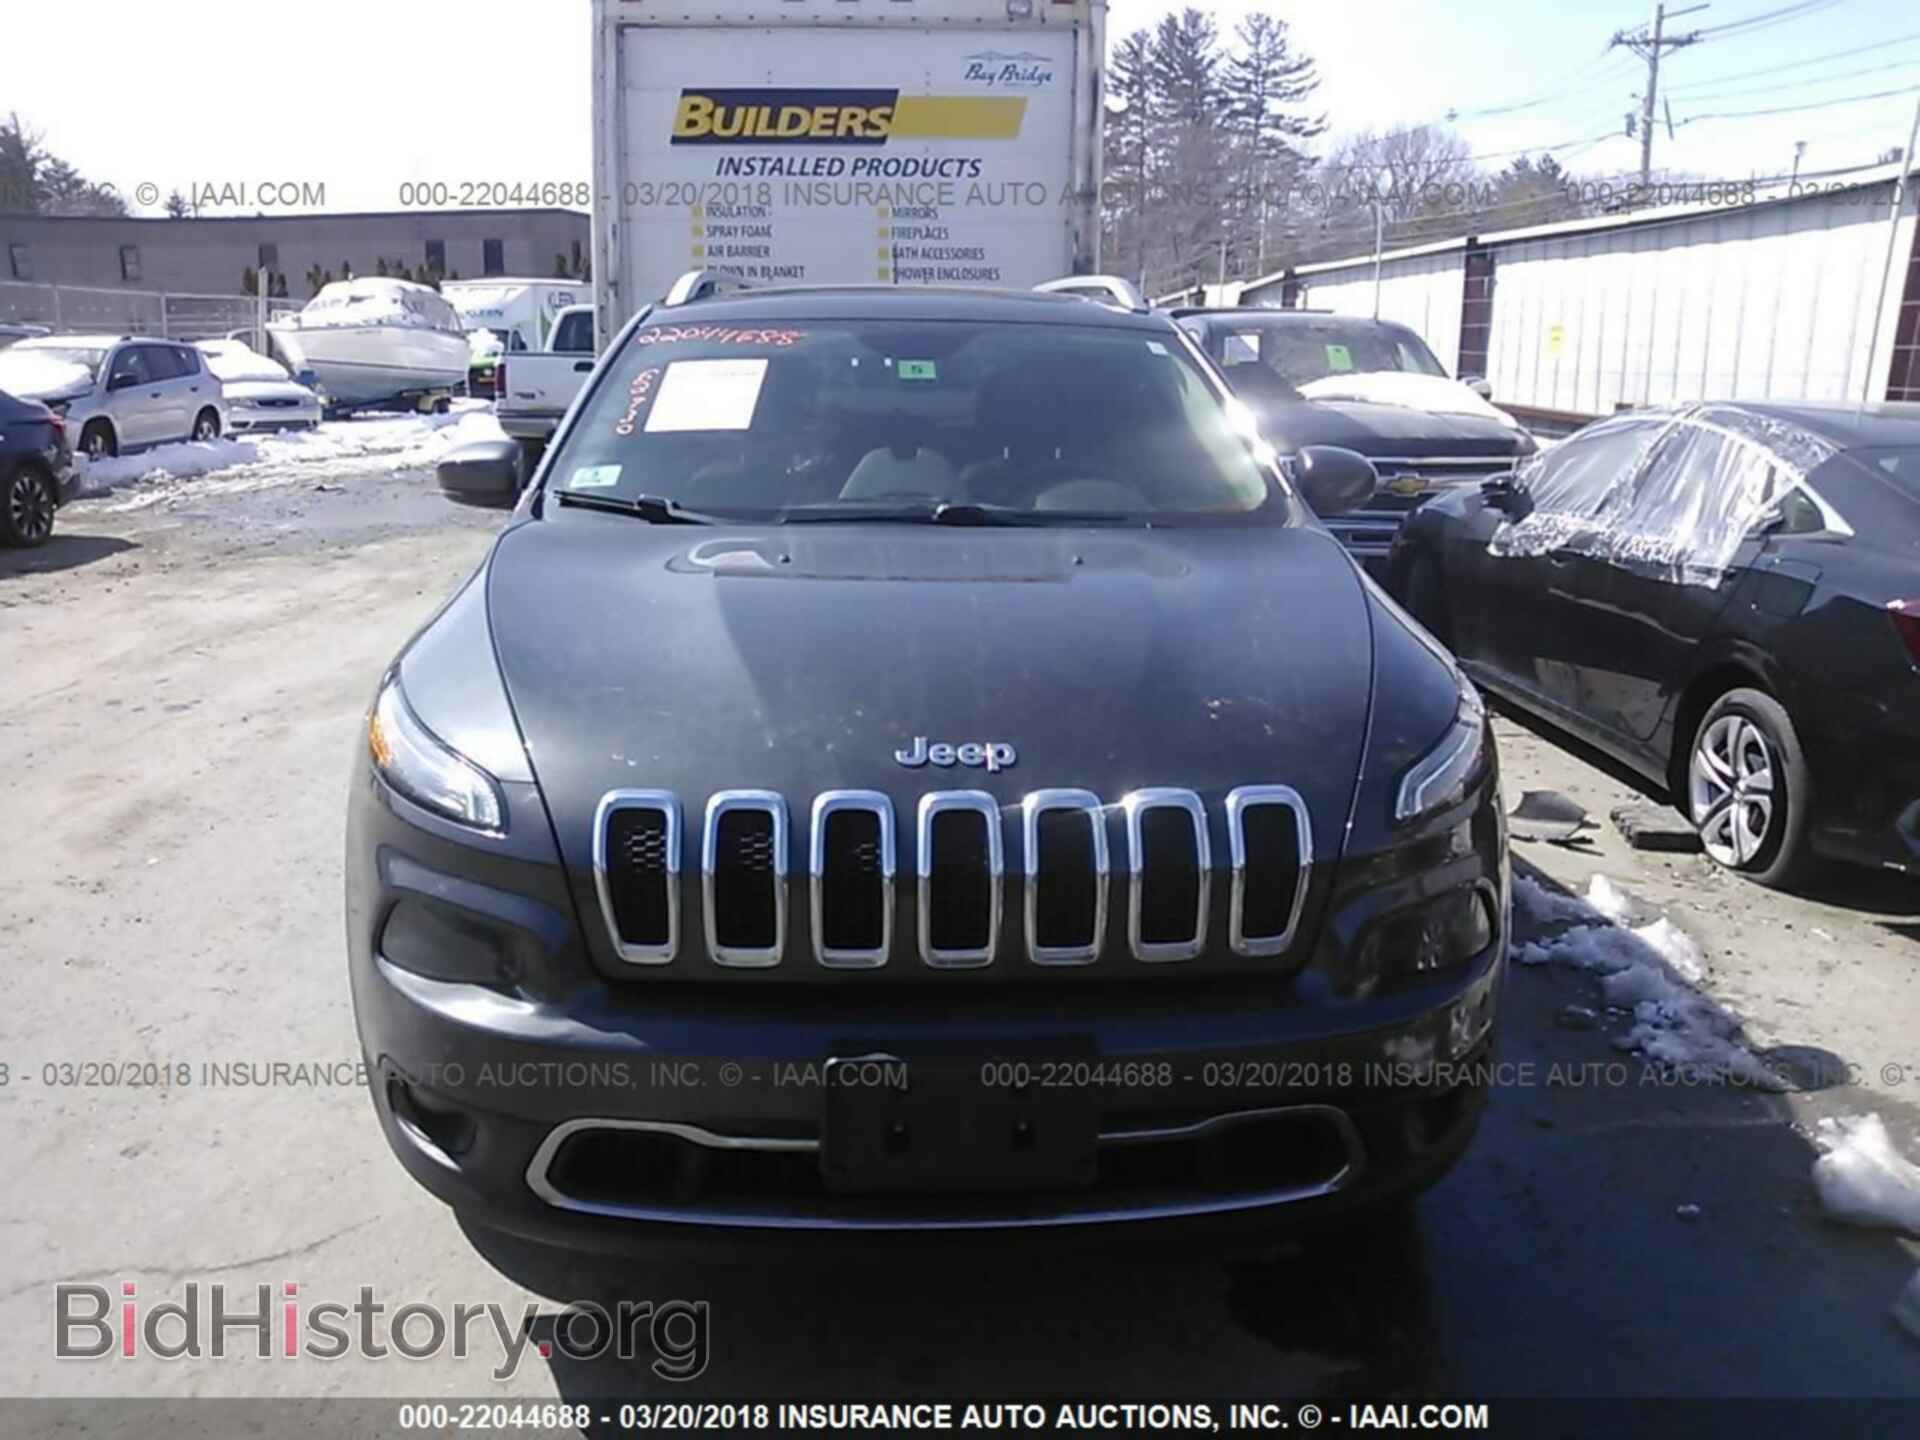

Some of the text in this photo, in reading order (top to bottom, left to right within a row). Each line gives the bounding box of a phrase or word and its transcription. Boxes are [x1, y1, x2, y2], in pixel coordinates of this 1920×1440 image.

[964, 63, 1052, 86] Bay Bridge
[673, 96, 892, 138] BUILDERS
[716, 157, 982, 178] INSTALLED PRODUCTS
[706, 224, 772, 238] SPRAY FOAM
[891, 226, 949, 240] FIREPLACES
[707, 245, 770, 258] AIR BARRIER
[921, 247, 985, 260] ACCESSORIES
[937, 267, 1000, 280] ENCLOSURES
[894, 736, 1017, 771] Jeep
